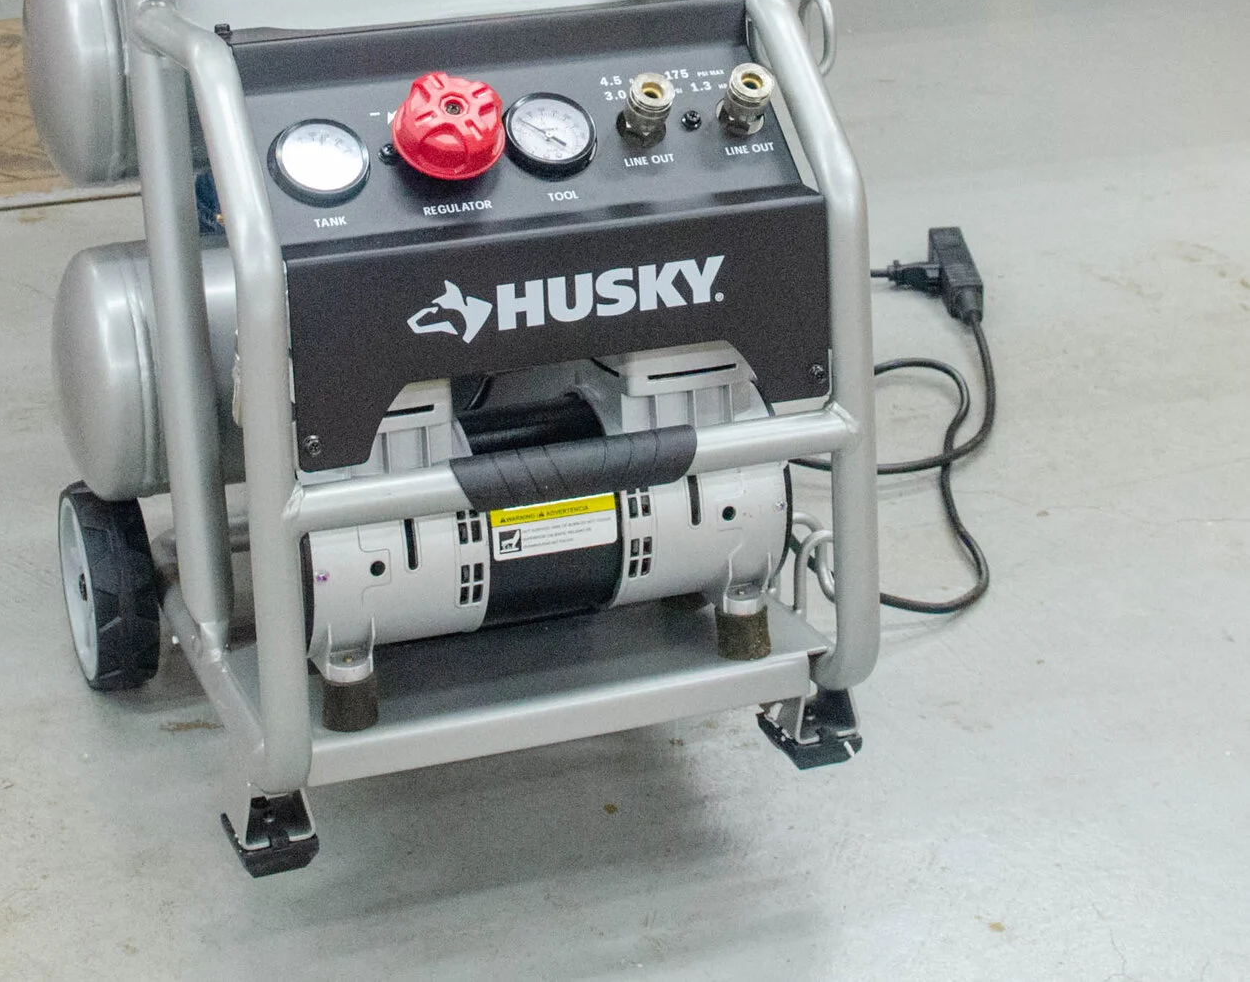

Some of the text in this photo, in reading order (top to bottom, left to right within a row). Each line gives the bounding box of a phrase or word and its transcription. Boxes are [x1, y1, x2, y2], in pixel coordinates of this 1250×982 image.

[600, 75, 623, 87] 4.5
[664, 68, 689, 80] 175
[604, 90, 627, 101] 3.0
[690, 81, 712, 92] 1.3
[725, 142, 775, 156] LINE OUT
[624, 153, 675, 167] LINE OUT
[547, 190, 580, 202] TOOL
[423, 199, 493, 217] REGULATOR
[314, 215, 348, 229] TANK
[498, 254, 725, 331] HUSKY
